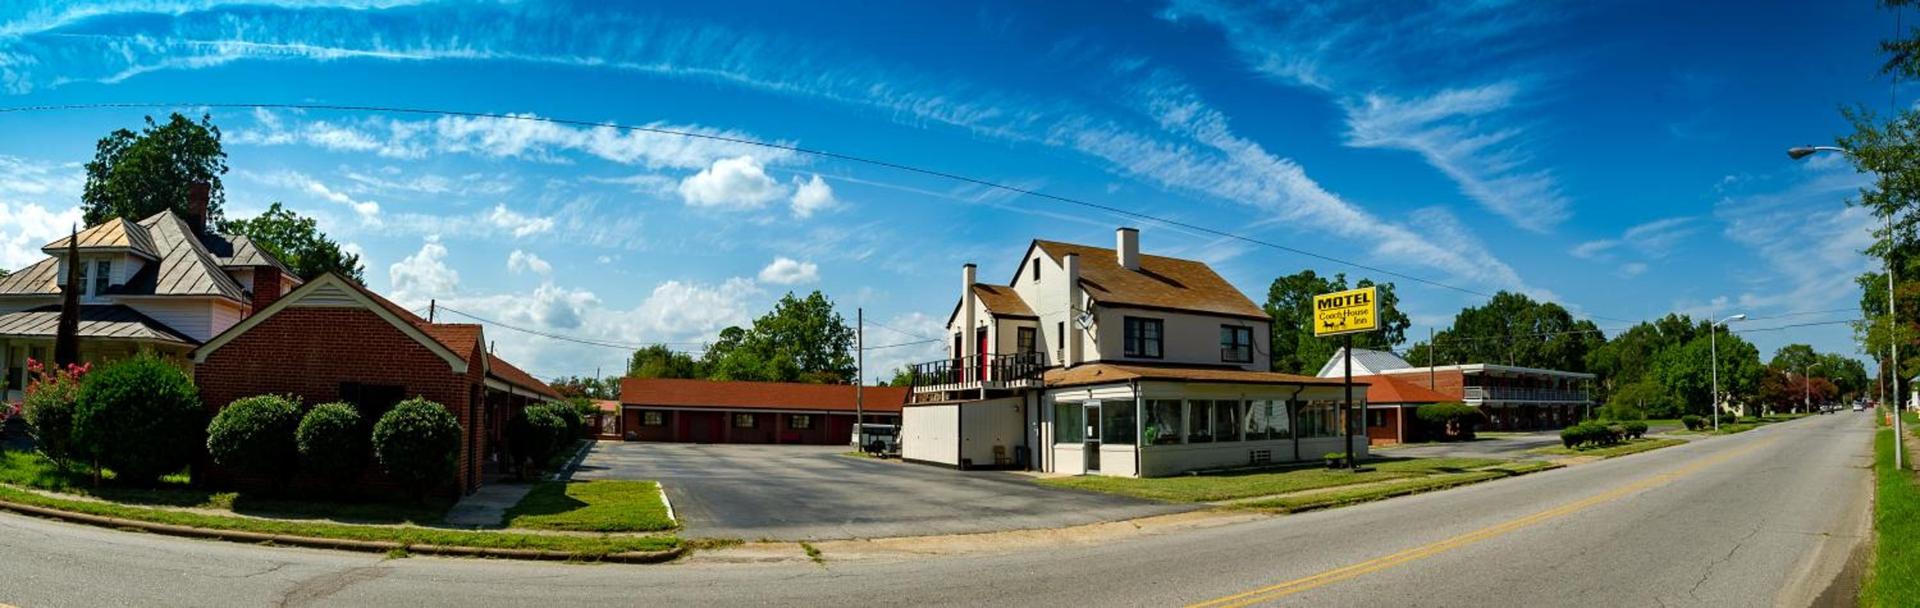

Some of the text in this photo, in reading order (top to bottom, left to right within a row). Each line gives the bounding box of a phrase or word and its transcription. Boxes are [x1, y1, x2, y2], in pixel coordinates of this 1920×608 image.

[1318, 293, 1370, 309] MOTEL
[1320, 308, 1369, 321] Coach House
[1354, 317, 1367, 325] Inn
